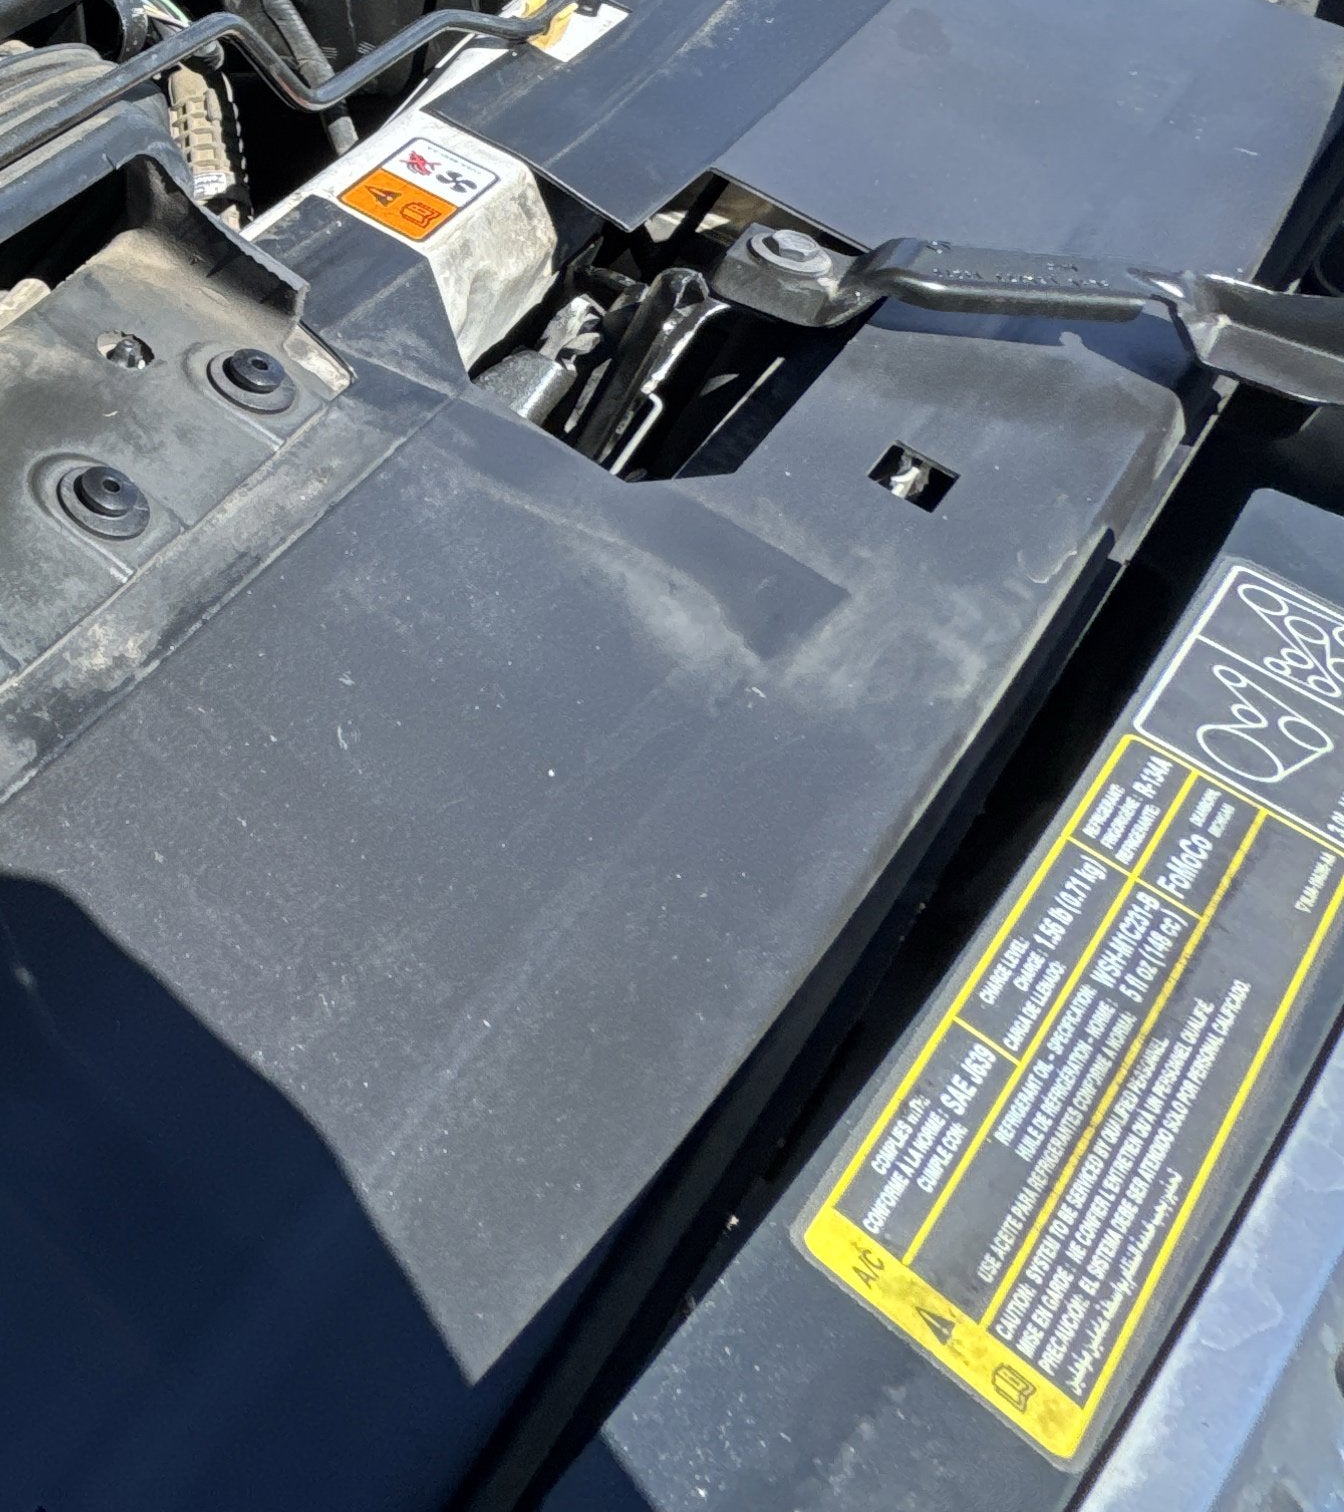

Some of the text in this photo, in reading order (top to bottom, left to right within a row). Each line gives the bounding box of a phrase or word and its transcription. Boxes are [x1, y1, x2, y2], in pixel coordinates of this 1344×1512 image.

[1131, 755, 1173, 798] R-134A
[1156, 833, 1212, 899] FoMoCo
[1032, 854, 1107, 950] 1.56 lb (0.71 kg)
[1089, 891, 1160, 988] WSH-M1C231-B
[1118, 906, 1188, 1002] 5 fl oz (148 cc)
[979, 936, 1030, 1004] CHARGE LEVEL:
[1012, 950, 1045, 991] CHARGE
[1002, 960, 1066, 1051] CARGA DE LLENADO:
[1084, 1000, 1115, 1039] NORME
[939, 1043, 996, 1115] SAE J639
[993, 1073, 1043, 1146] REFRIGERANT
[1032, 1059, 1054, 1078] OIL
[1046, 984, 1097, 1055] SPECIFICATION:
[1039, 1039, 1093, 1117] RÉFRIGÉRATION
[1151, 1041, 1192, 1099] PERSONNEL
[912, 1110, 945, 1153] NORME
[1031, 1111, 1052, 1132] DE
[1143, 1093, 1164, 1114] UN
[870, 1119, 913, 1175] COMPLIES
[903, 1147, 924, 1168] LA
[916, 1122, 968, 1193] CUMPLE CON:
[977, 1252, 1001, 1283] USE
[989, 1213, 1023, 1260] ACEITE
[1010, 1186, 1039, 1221] PARA
[1026, 1106, 1083, 1192] REFRIGERANTES
[1072, 1053, 1112, 1111] CONFORME
[1104, 1011, 1137, 1051] NORMA:
[1014, 1125, 1044, 1161] HUILE
[1098, 1132, 1143, 1201] L'ENTRETIEN
[862, 1170, 909, 1233] CONFORME
[995, 1037, 1169, 1340] CAUTION: SYSTEM TO BE SERVICED BY QUALIFIED PERSONNEL.
[1037, 979, 1251, 1375] PRECAUCIÓN: EL SISTEMA DEBE SER ATENDIDO SOLO POR PERSONAL CALIFICADO.
[1074, 1194, 1111, 1246] CONFIER
[854, 1250, 882, 1282] A/C
[1064, 1239, 1086, 1264] NE
[1031, 1304, 1053, 1329] EN
[1040, 1265, 1074, 1311] GARDE
[1015, 1322, 1044, 1358] MISE
